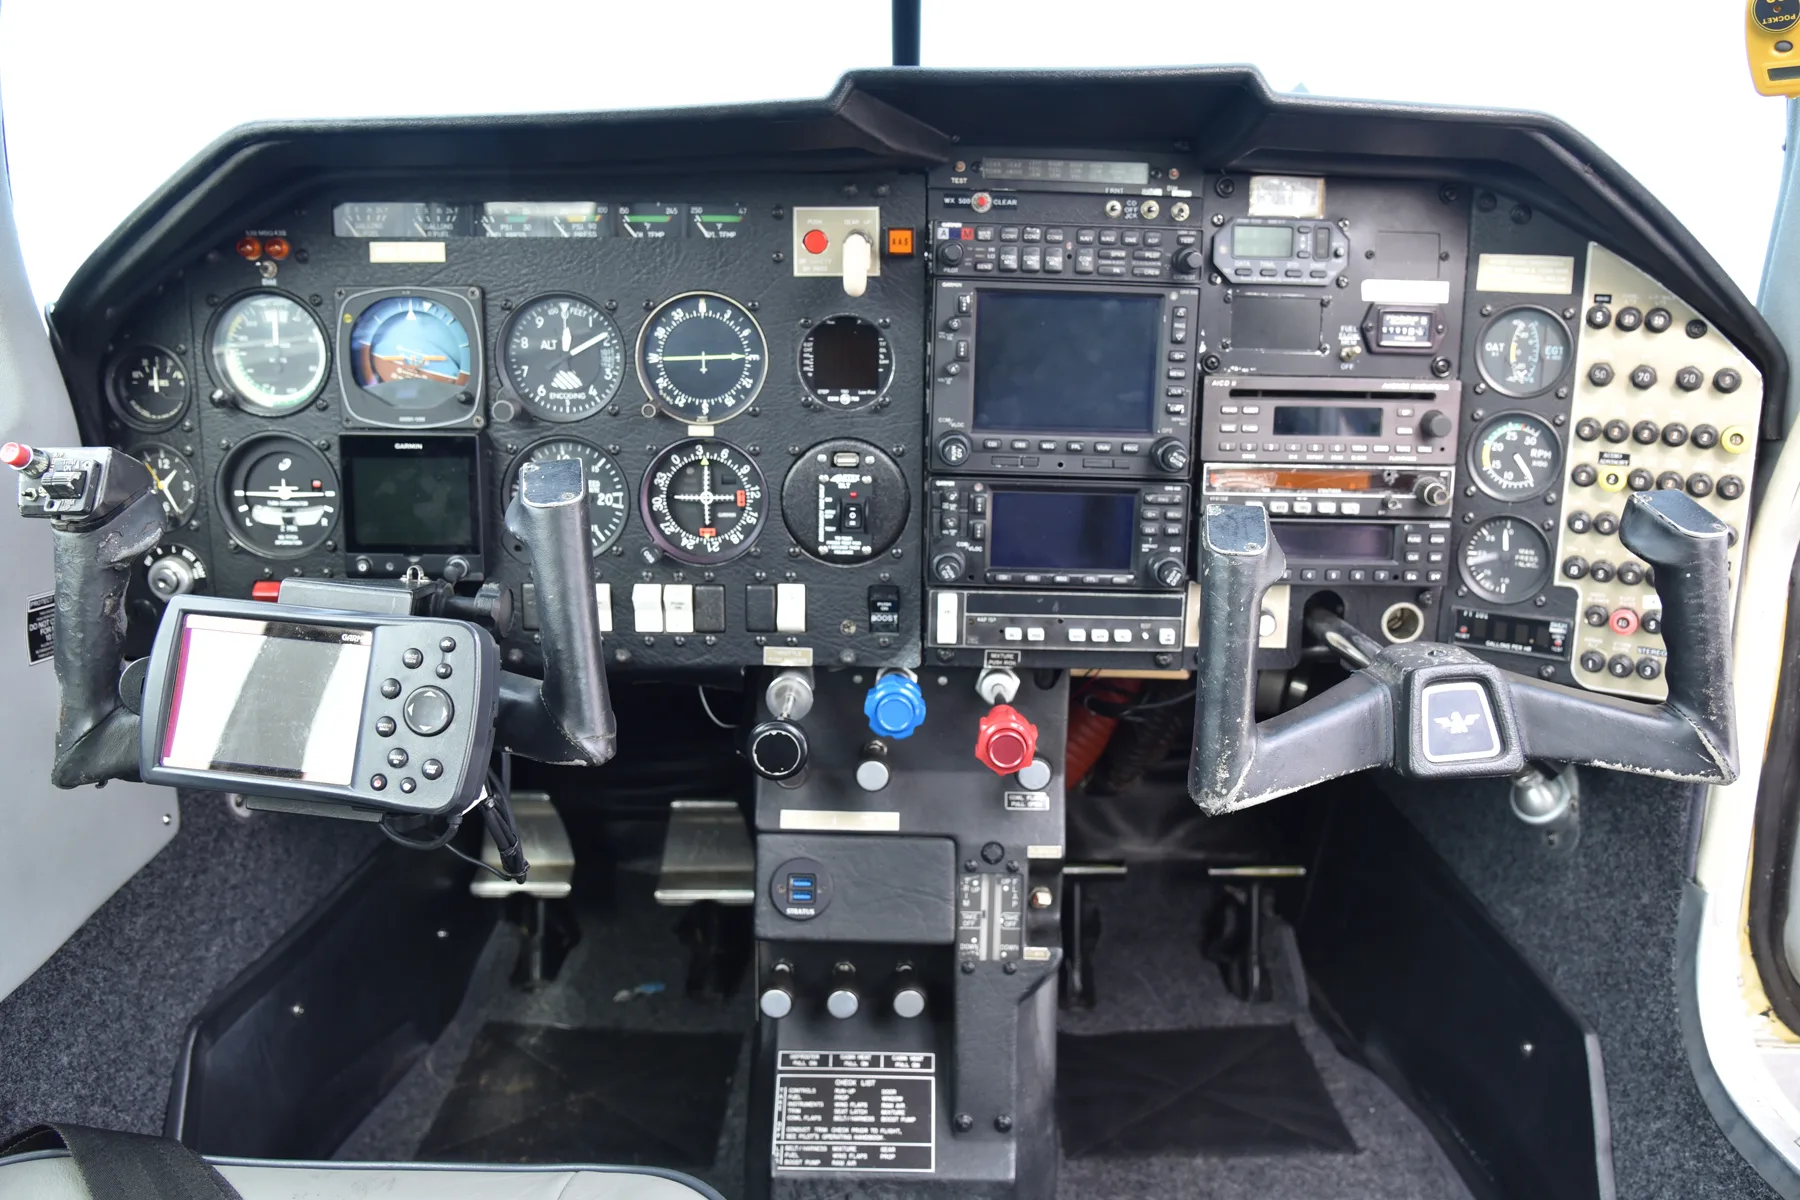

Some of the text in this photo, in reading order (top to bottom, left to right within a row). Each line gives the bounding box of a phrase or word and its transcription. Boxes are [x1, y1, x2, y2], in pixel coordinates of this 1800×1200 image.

[1762, 14, 1796, 25] POCKET
[993, 199, 1018, 207] CLEAR
[535, 316, 544, 328] 9
[521, 336, 529, 349] 8
[540, 340, 558, 350] ALT
[1485, 342, 1505, 352] OAT
[521, 365, 529, 377] 7
[604, 368, 612, 380] 3
[1637, 372, 1650, 382] 70
[1683, 374, 1696, 383] 70
[537, 384, 546, 396] 6
[588, 384, 597, 396] 4
[1505, 431, 1518, 441] 25
[695, 444, 704, 456] 3
[1491, 441, 1504, 452] 20
[670, 454, 681, 465] 0
[720, 448, 730, 459] 6
[1530, 448, 1552, 459] RPM
[158, 458, 170, 470] 12
[740, 464, 751, 475] 9
[654, 471, 667, 487] 33
[1609, 475, 1615, 484] 2
[750, 485, 761, 499] 12
[597, 492, 613, 506] 20
[651, 496, 663, 511] 30
[746, 511, 759, 525] 15
[660, 521, 675, 535] 27
[681, 537, 696, 550] 24
[730, 532, 744, 545] 18
[707, 542, 720, 553] 21
[871, 614, 898, 623] BOOST
